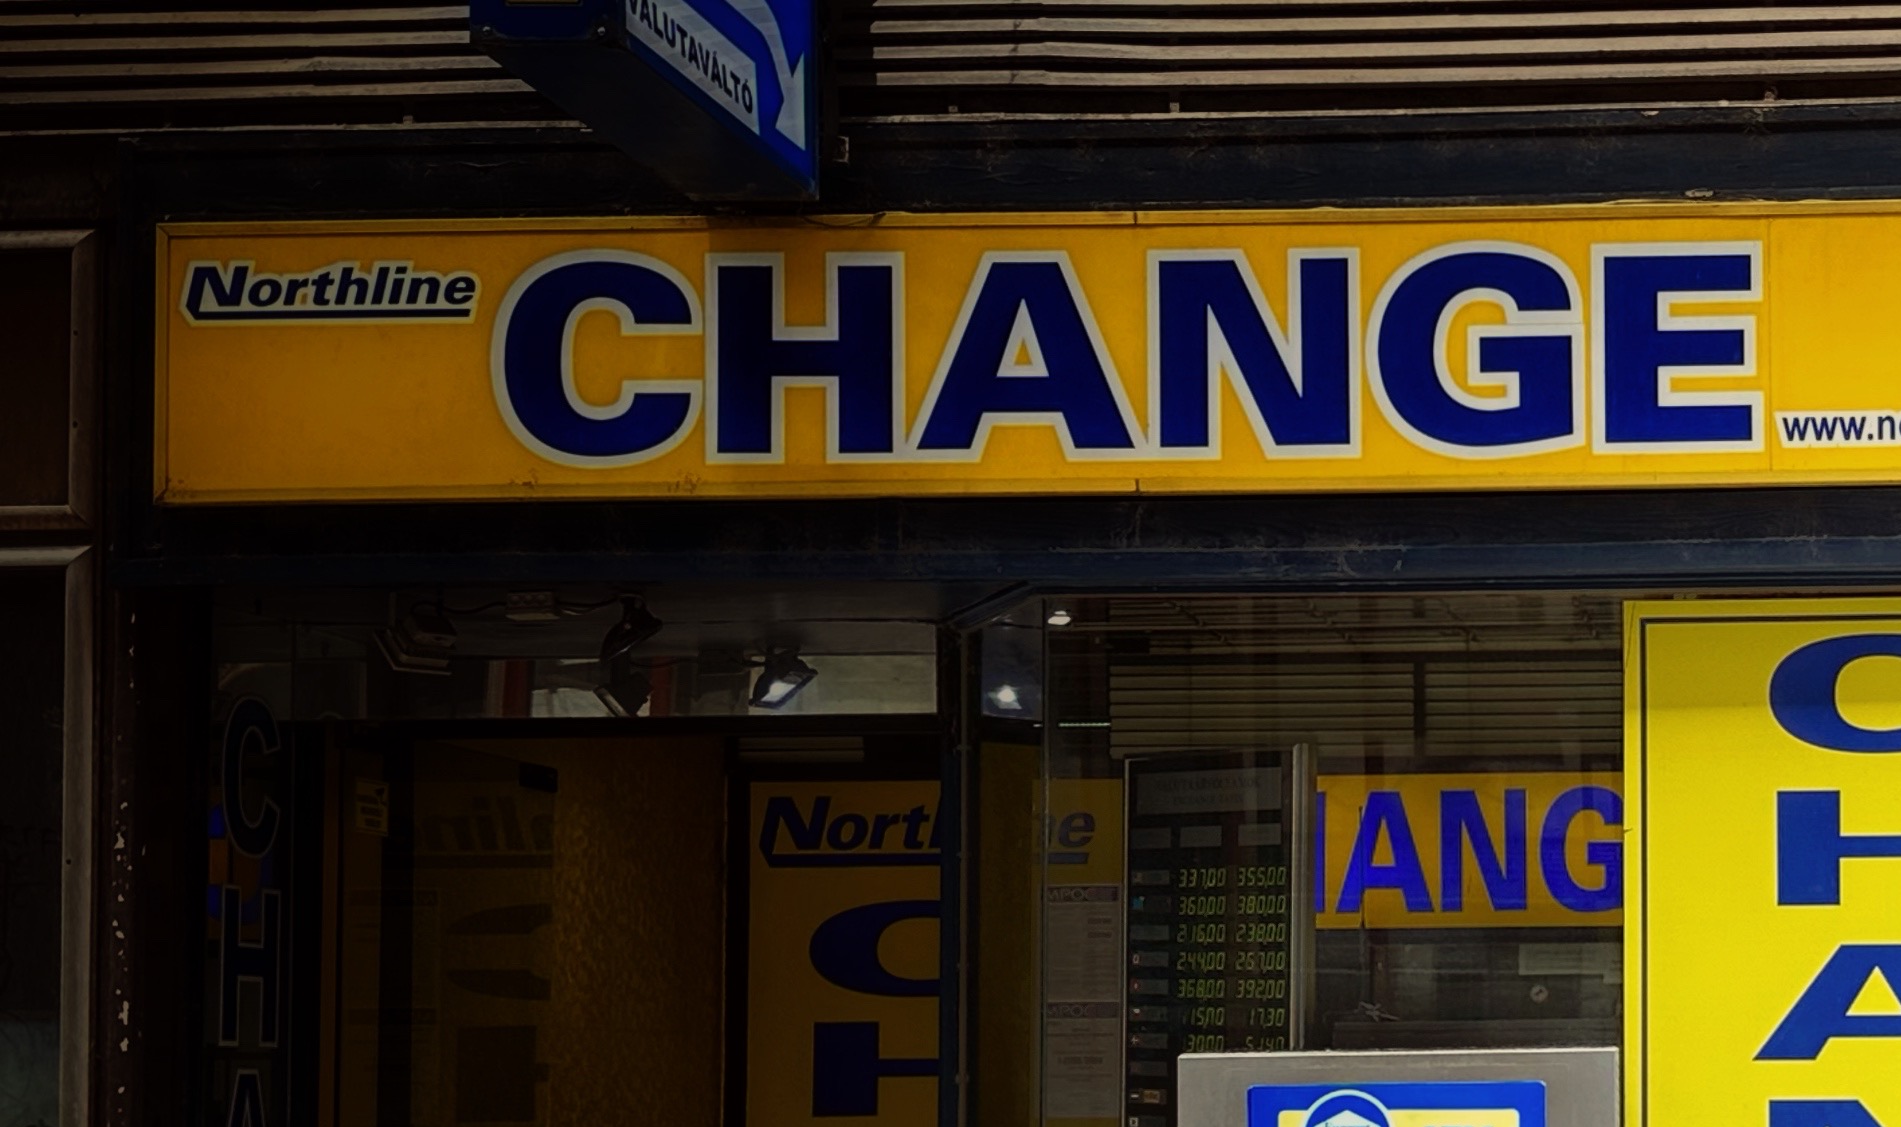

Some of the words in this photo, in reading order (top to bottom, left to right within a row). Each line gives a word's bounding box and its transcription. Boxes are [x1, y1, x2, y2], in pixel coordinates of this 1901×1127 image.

[188, 261, 477, 312] Northline
[492, 242, 1764, 467] CHANGE
[1316, 788, 1623, 913] ANG
